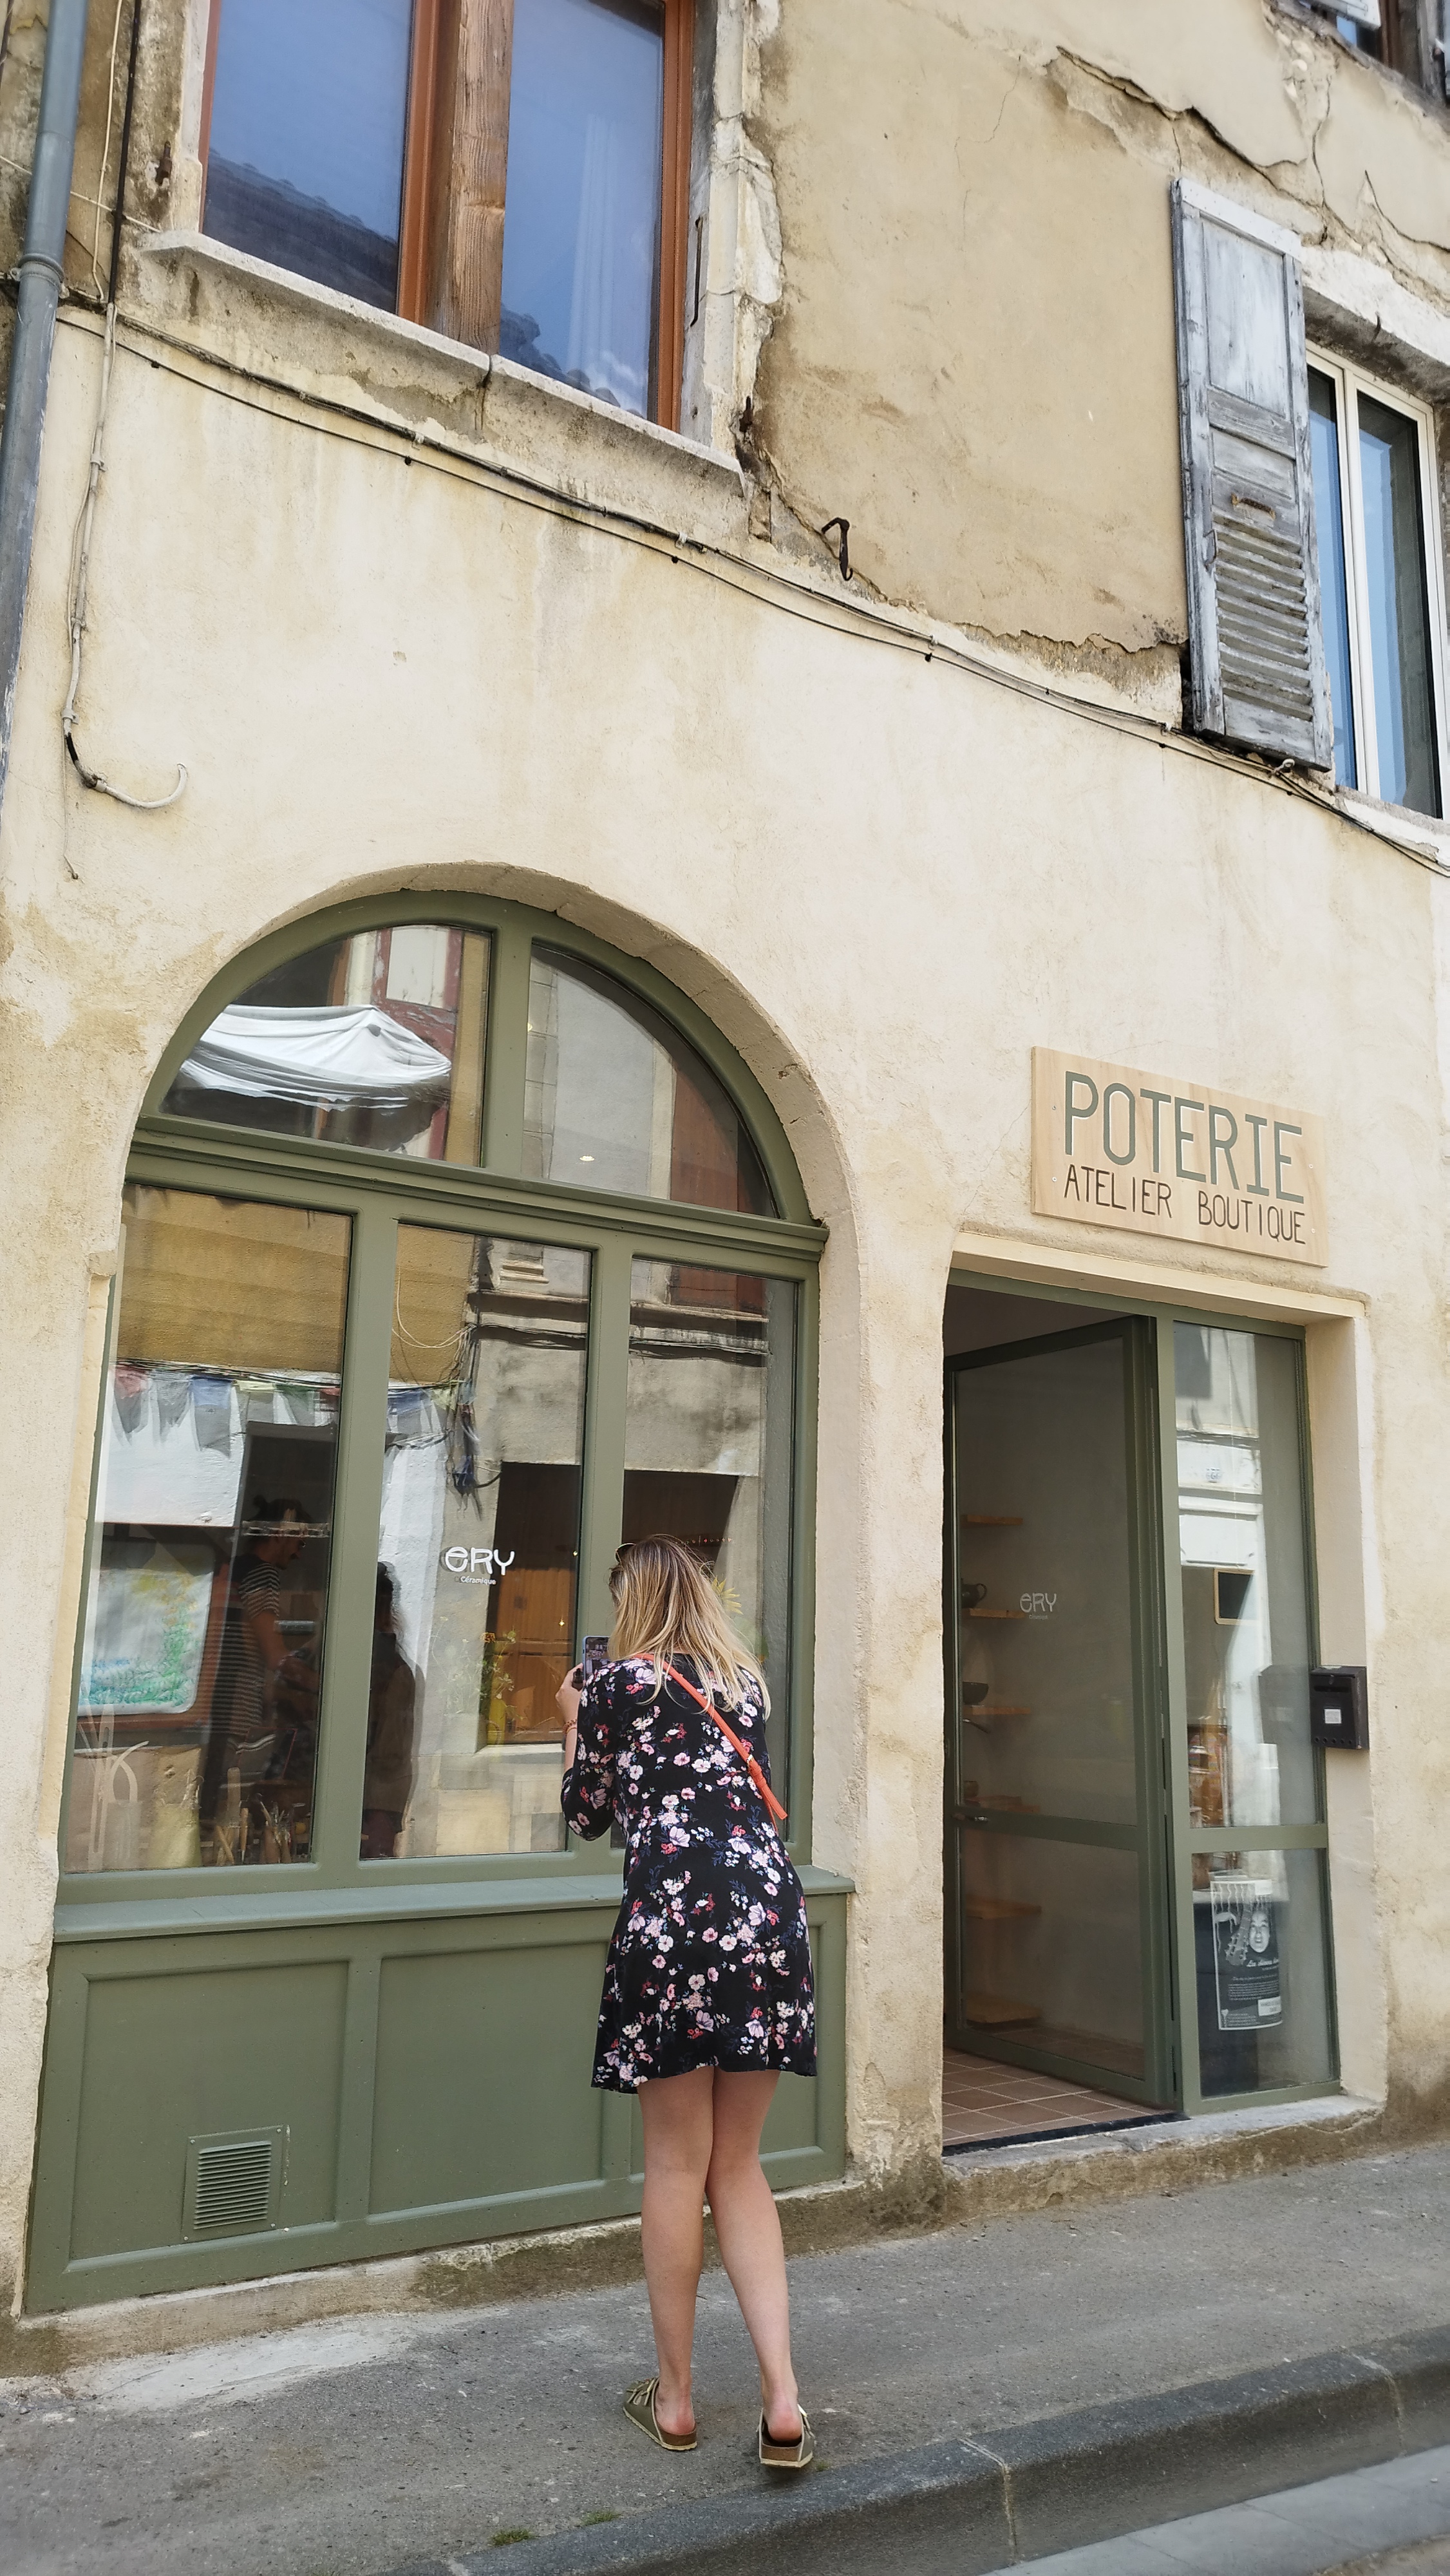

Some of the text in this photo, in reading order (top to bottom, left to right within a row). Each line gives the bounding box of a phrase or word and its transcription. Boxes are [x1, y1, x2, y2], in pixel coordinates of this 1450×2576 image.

[1064, 1070, 1304, 1204] POTERIE
[1064, 1164, 1306, 1245] ATELIER BOUTIQUE
[460, 1575, 496, 1586] Céramique
